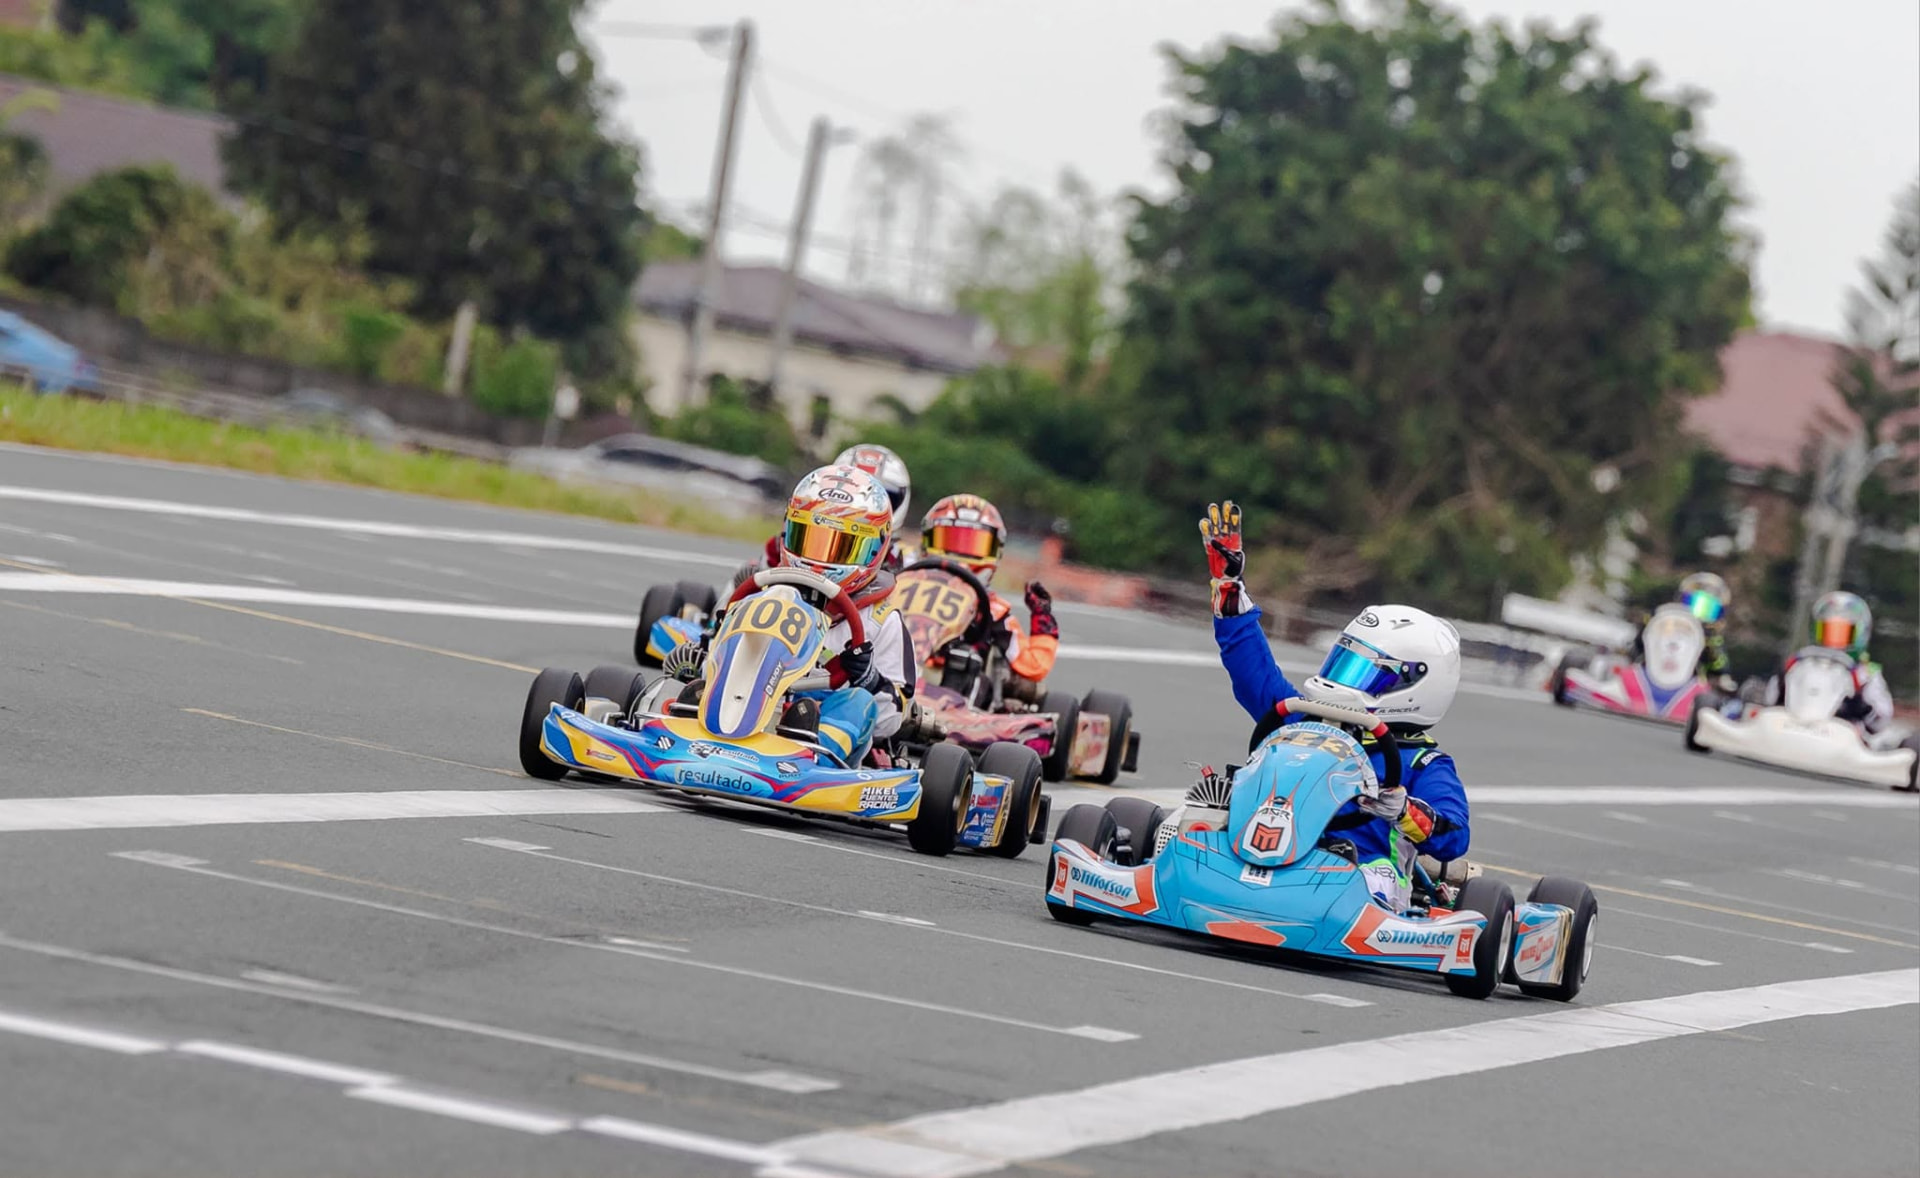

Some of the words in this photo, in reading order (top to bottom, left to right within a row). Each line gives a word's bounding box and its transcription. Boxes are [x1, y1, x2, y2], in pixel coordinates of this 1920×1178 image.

[824, 488, 850, 501] Arai
[900, 582, 965, 621] 115
[731, 598, 807, 646] 108
[769, 660, 783, 686] RUDY
[678, 767, 752, 792] resultado
[862, 787, 896, 795] MIKEL
[858, 801, 898, 809] RACING
[1080, 870, 1133, 898] Tillotson
[1391, 930, 1455, 945] Tillotson
